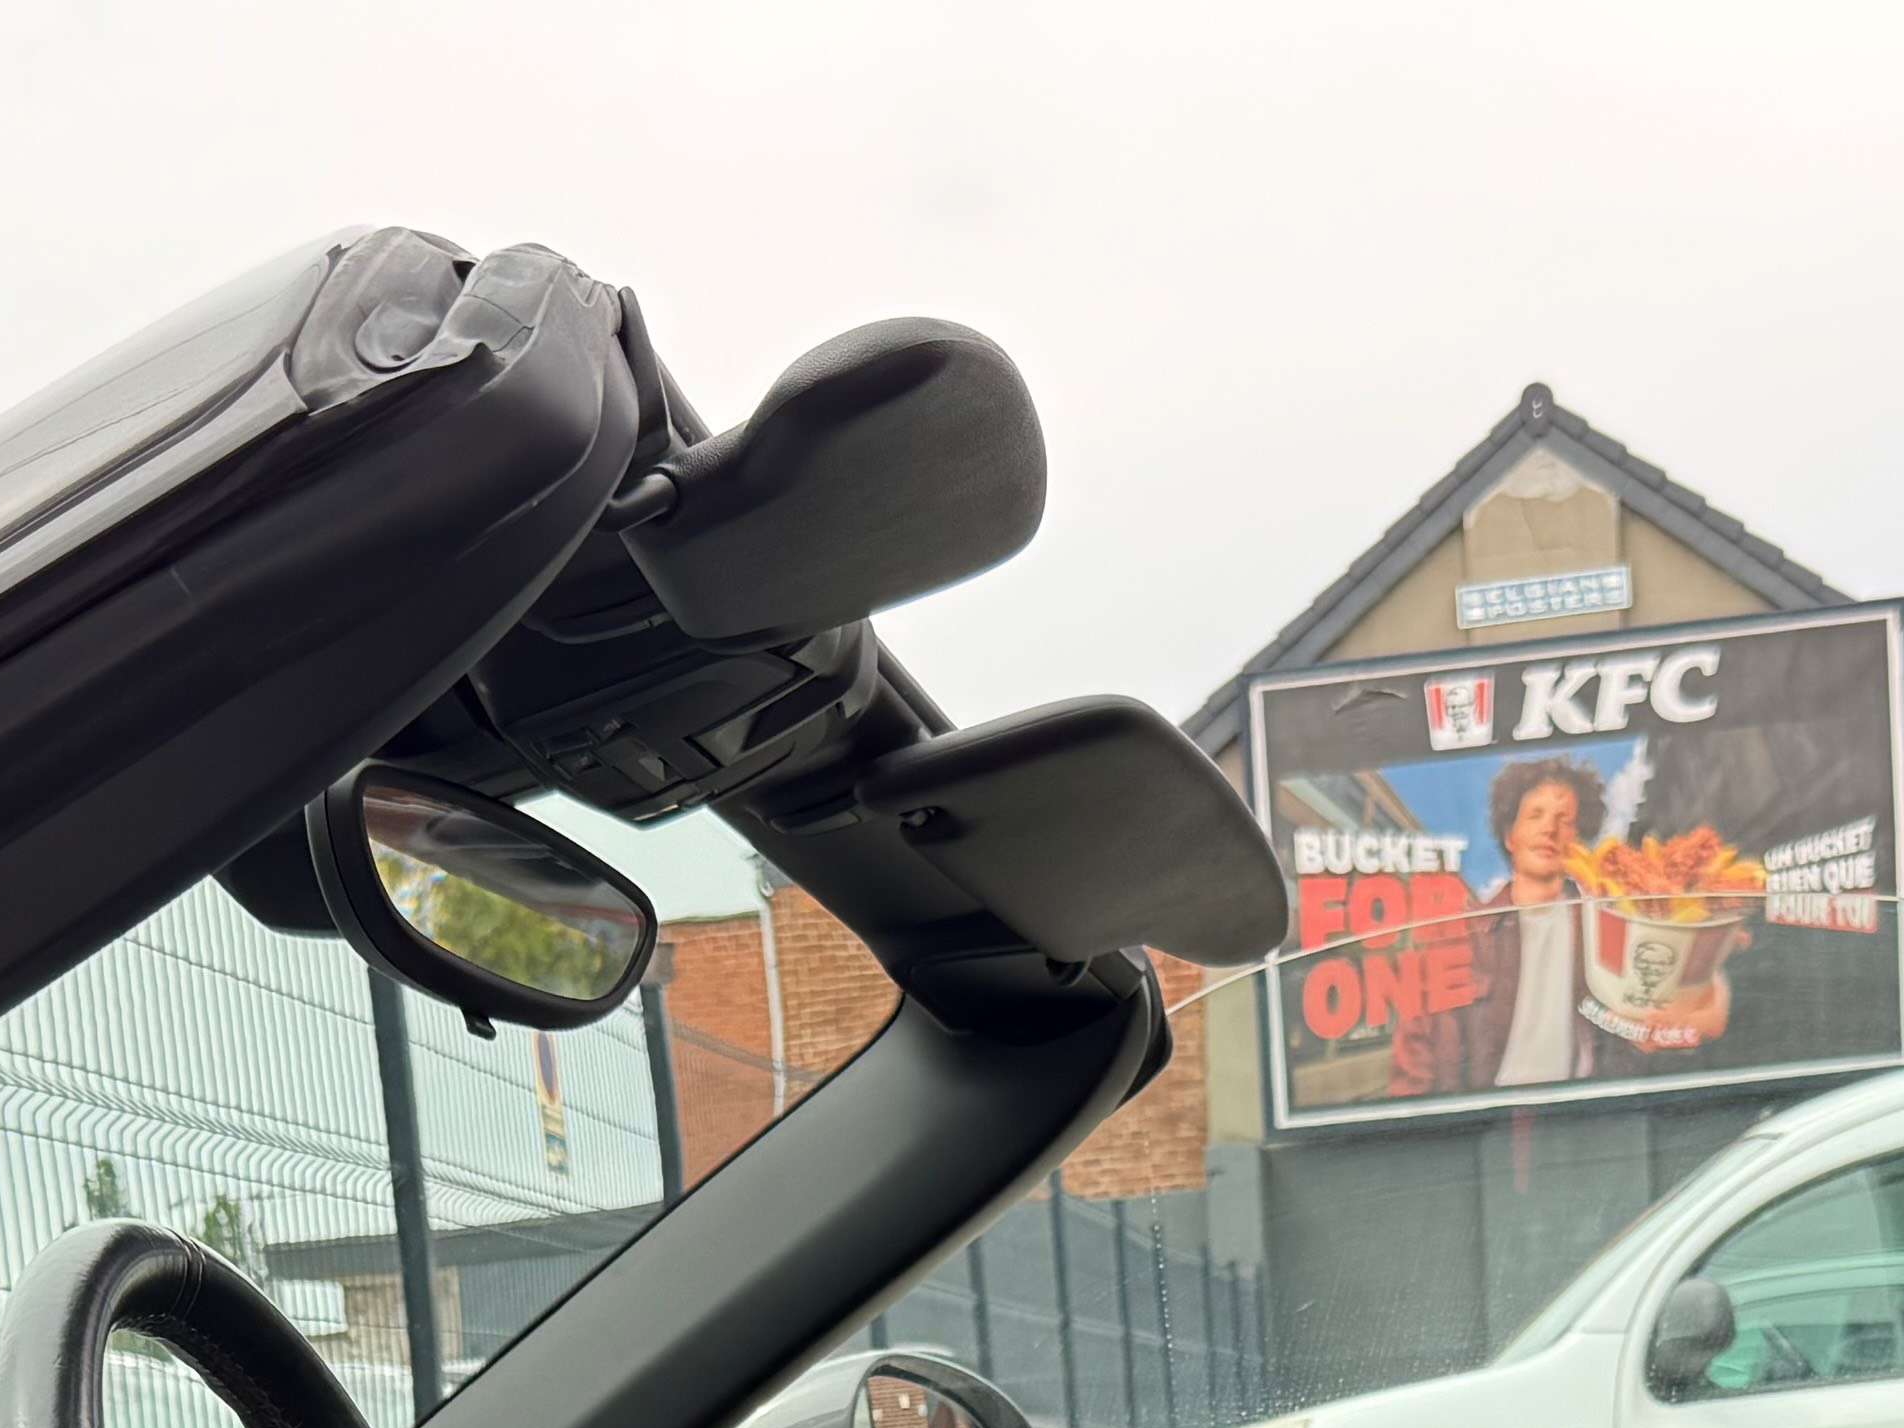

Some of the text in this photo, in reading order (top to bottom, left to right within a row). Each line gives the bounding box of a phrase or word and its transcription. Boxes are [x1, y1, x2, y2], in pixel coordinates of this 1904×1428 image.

[1512, 646, 1721, 741] KFC
[1295, 831, 1469, 876] BUCKET
[1299, 873, 1471, 951] FOR
[1302, 942, 1481, 1040] ONE
